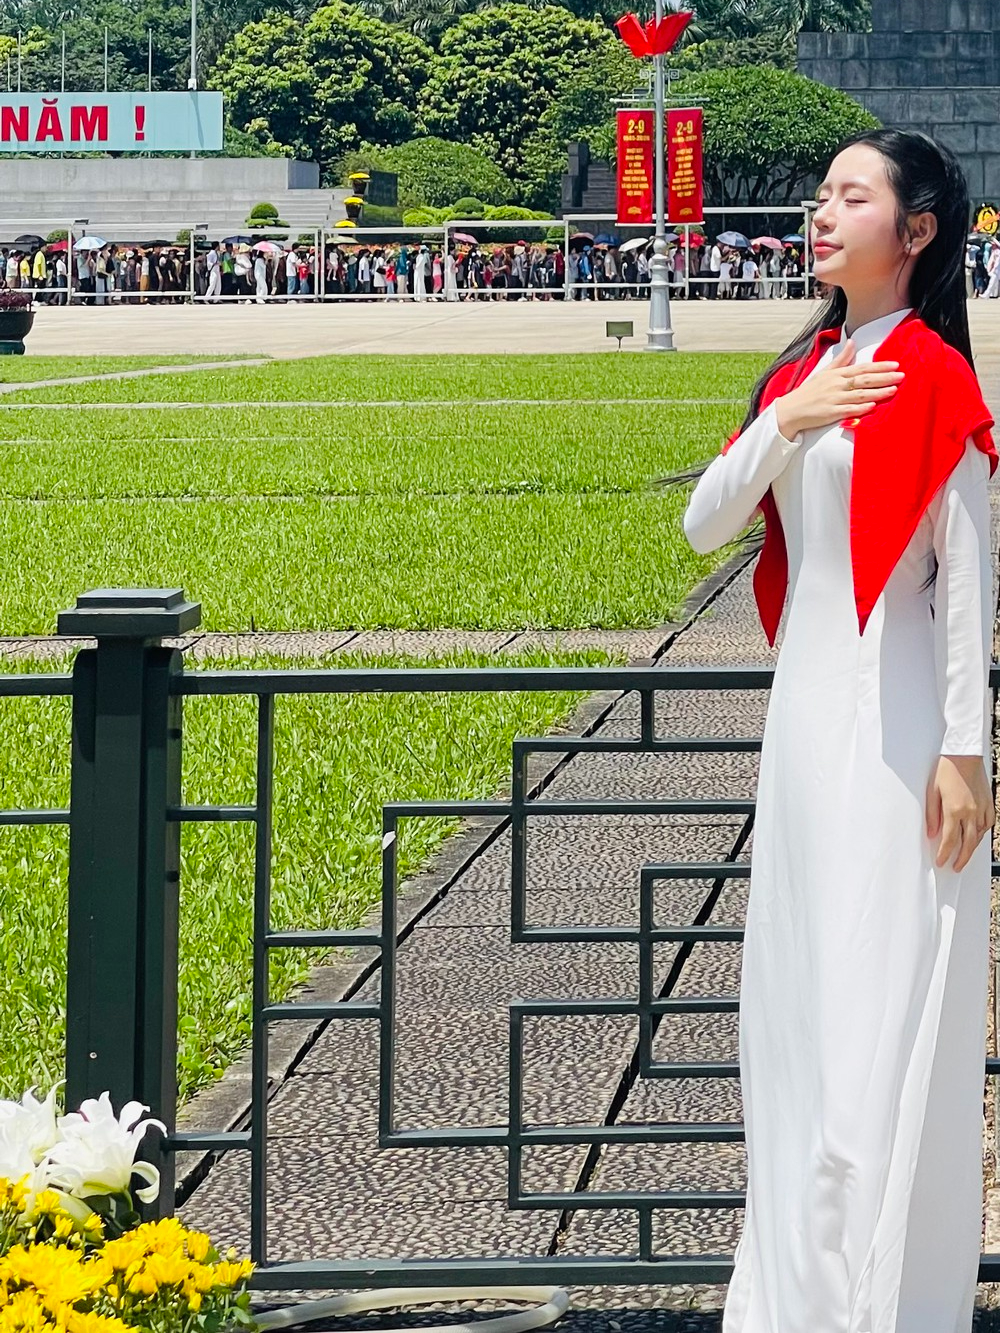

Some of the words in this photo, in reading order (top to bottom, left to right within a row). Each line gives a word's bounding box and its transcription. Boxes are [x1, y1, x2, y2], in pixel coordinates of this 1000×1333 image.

[1, 97, 109, 142] NĂM
[135, 106, 145, 141] !
[628, 119, 645, 134] 2-9
[677, 120, 693, 136] 2-9
